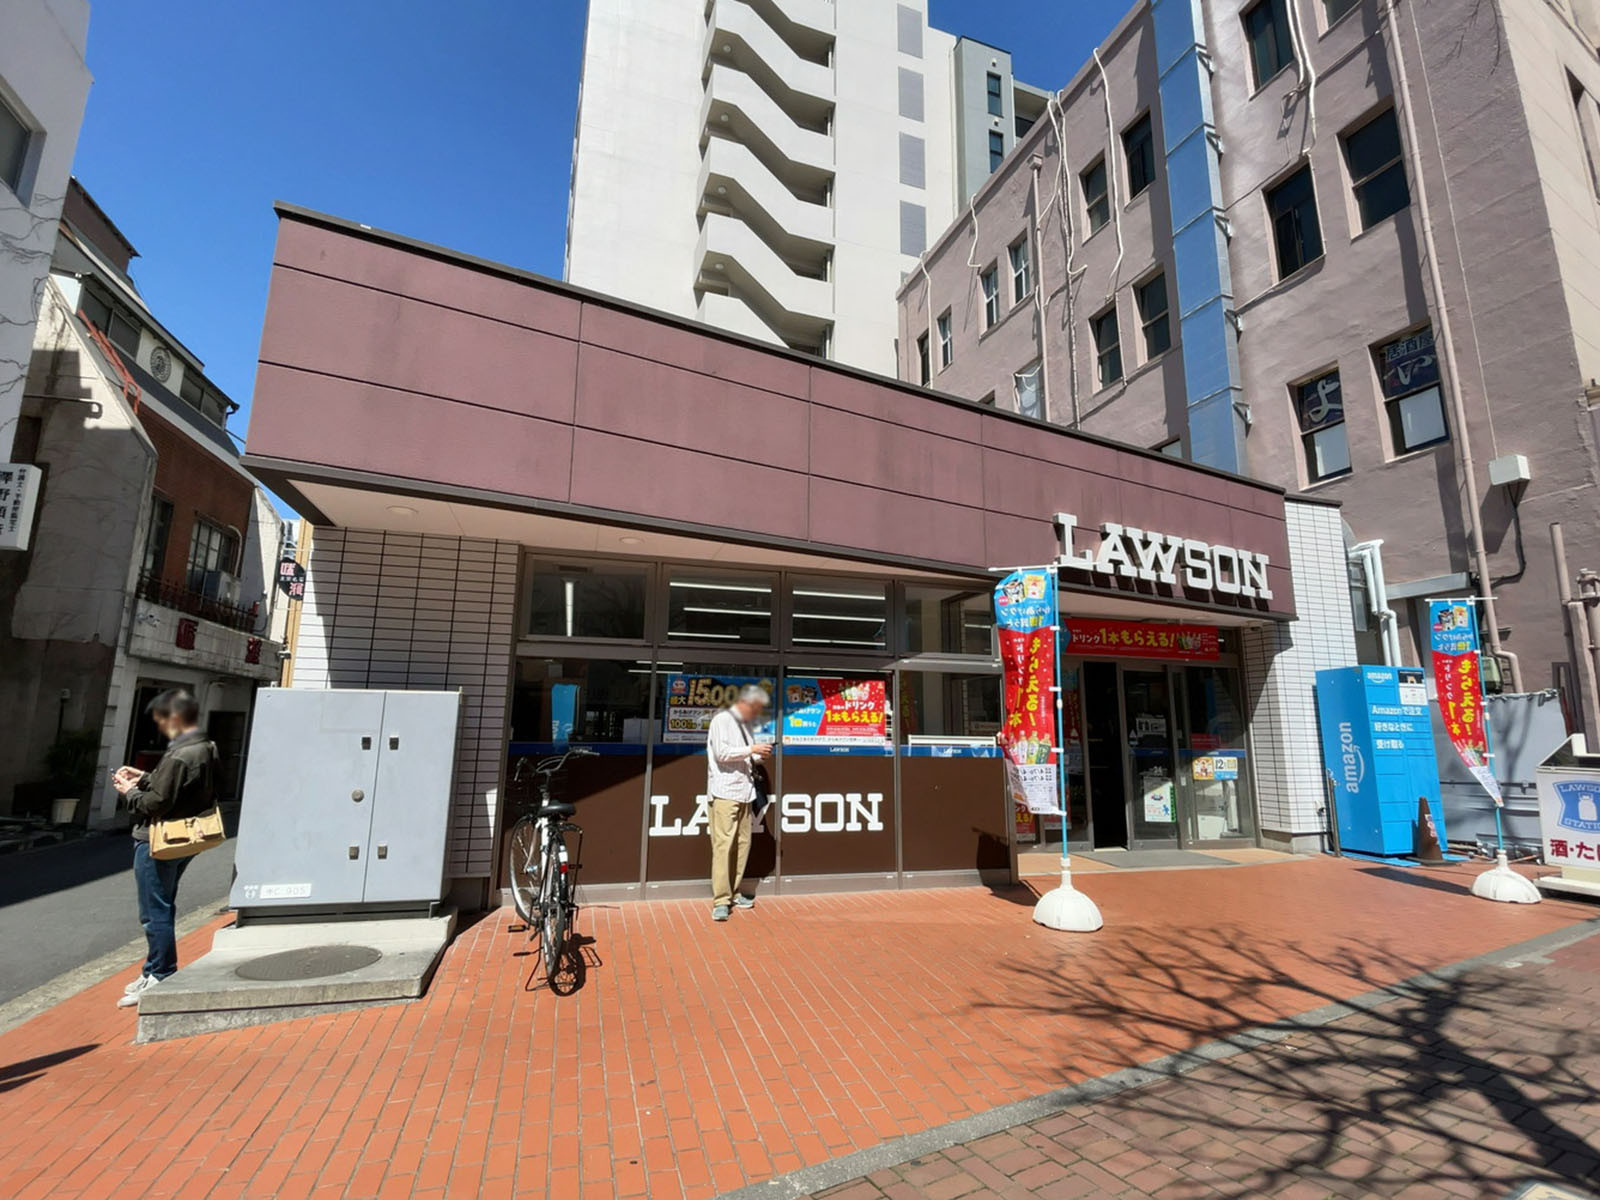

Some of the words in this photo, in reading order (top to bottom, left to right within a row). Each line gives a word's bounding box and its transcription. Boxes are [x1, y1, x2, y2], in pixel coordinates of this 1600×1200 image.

[1053, 511, 1273, 600] LAWSON
[825, 711, 884, 723] 1本もらえる!
[1338, 722, 1361, 794] amazon
[649, 793, 883, 836] LASON
[1550, 839, 1600, 861] 酒・た
